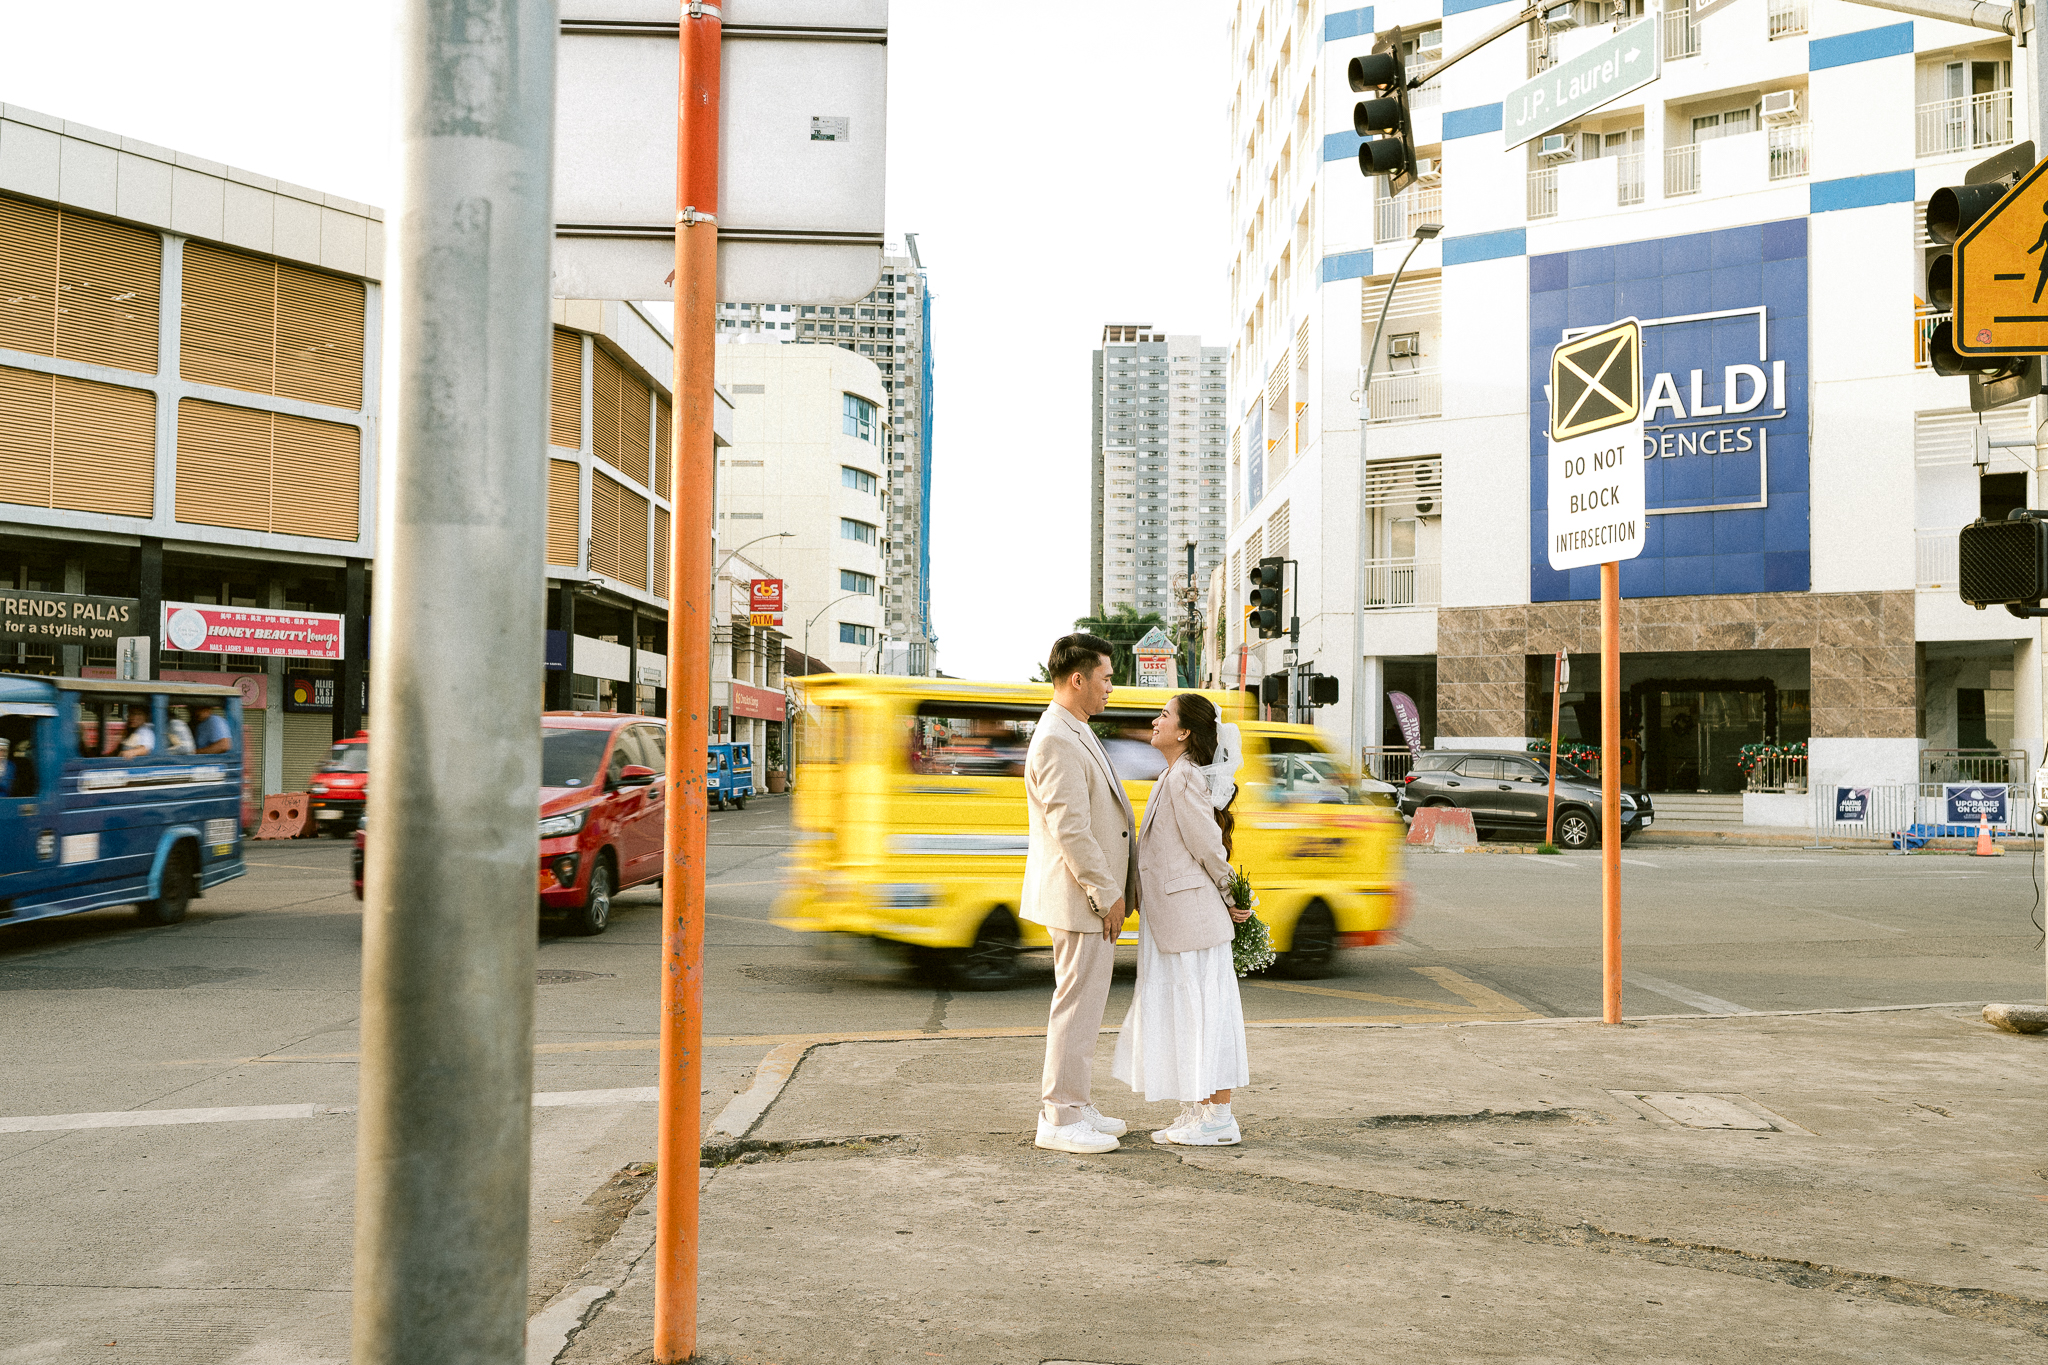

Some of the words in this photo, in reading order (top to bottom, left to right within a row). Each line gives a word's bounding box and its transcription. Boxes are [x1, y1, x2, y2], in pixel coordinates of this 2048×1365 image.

[1516, 88, 1550, 127] J.P.
[1556, 47, 1620, 108] Laurel
[1643, 360, 1786, 422] ALDI
[1644, 426, 1753, 460] DENCES
[1565, 456, 1586, 479] DO
[1594, 445, 1625, 471] NOT
[1570, 485, 1620, 514] BLOCK
[1556, 520, 1635, 553] INTERSECTION
[72, 602, 130, 622] PALAS
[752, 614, 773, 625] ATM
[5, 620, 25, 633] for
[28, 624, 37, 634] a
[40, 622, 87, 638] stylish
[90, 627, 113, 639] you
[207, 625, 255, 639] HONEY
[254, 628, 307, 642] BEAUTY
[1143, 631, 1166, 648] City
[1396, 704, 1415, 746] AVAILABLE
[1408, 717, 1420, 738] SALE
